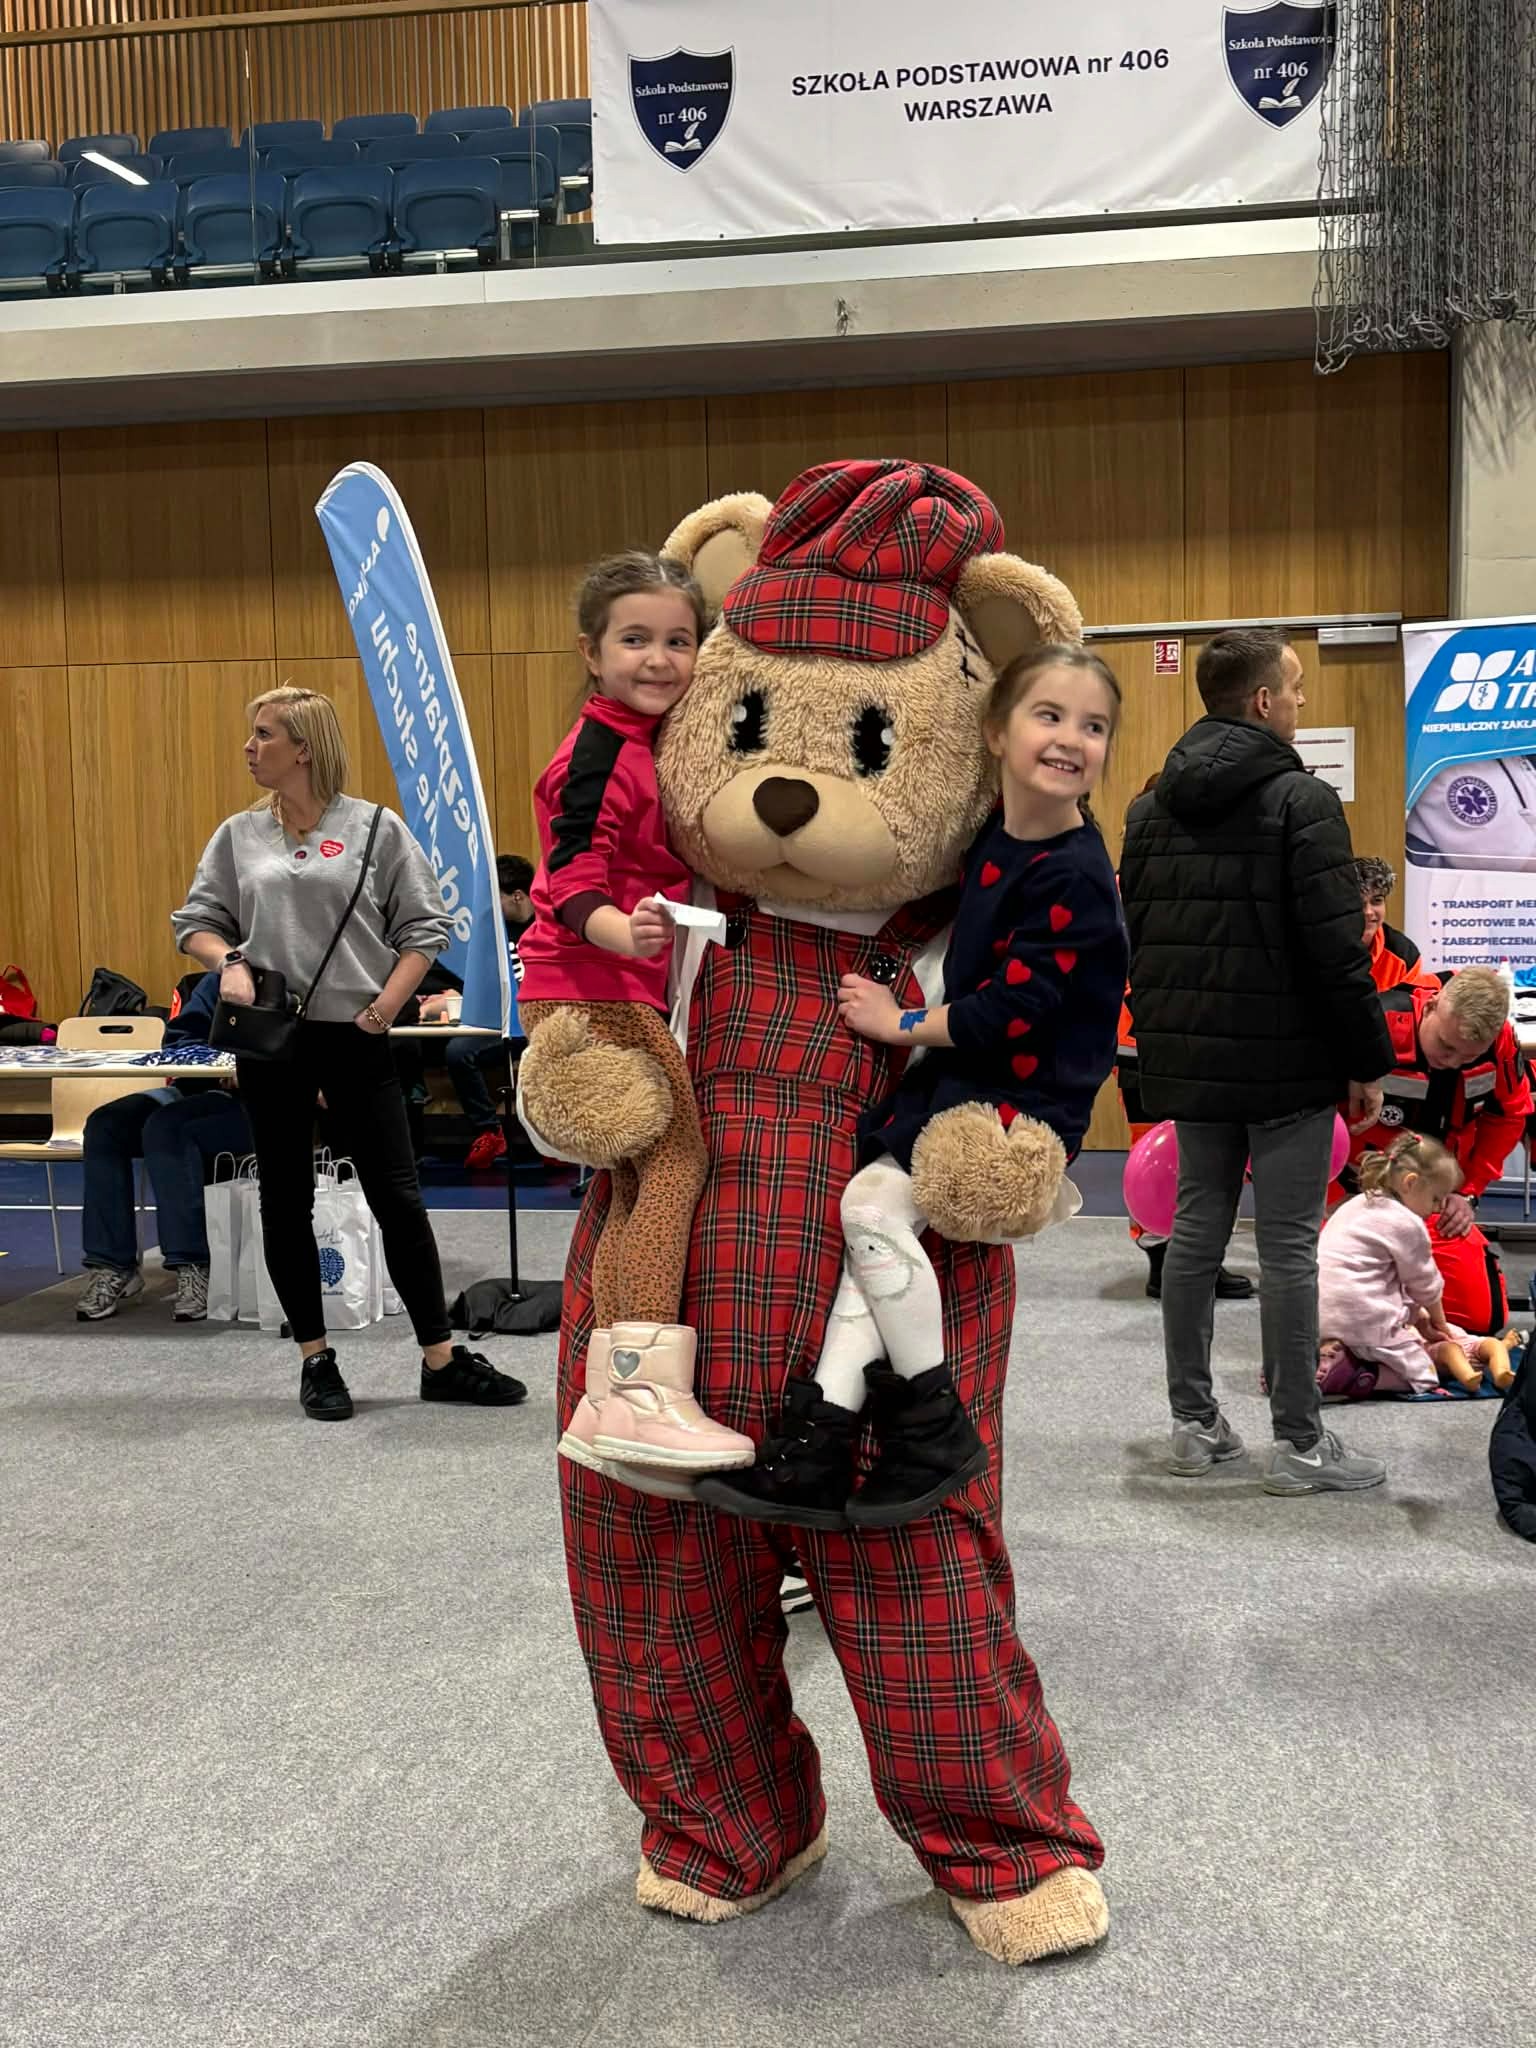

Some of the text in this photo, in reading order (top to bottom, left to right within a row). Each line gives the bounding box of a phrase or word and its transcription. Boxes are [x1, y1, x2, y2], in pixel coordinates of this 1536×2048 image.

[1228, 37, 1264, 51] Szkoła
[791, 48, 1170, 96] SZKOŁA PODSTAWOWA nr 406
[1253, 61, 1309, 79] nr 406
[668, 81, 729, 94] Podstawowa
[904, 92, 1053, 122] WARSZAWA
[658, 106, 708, 125] nr 406
[1510, 649, 1536, 676] A
[1422, 721, 1500, 734] NIEPUBLICZNY
[1442, 899, 1514, 909] TRANSPORT
[1442, 918, 1516, 927] POGOTOWIE
